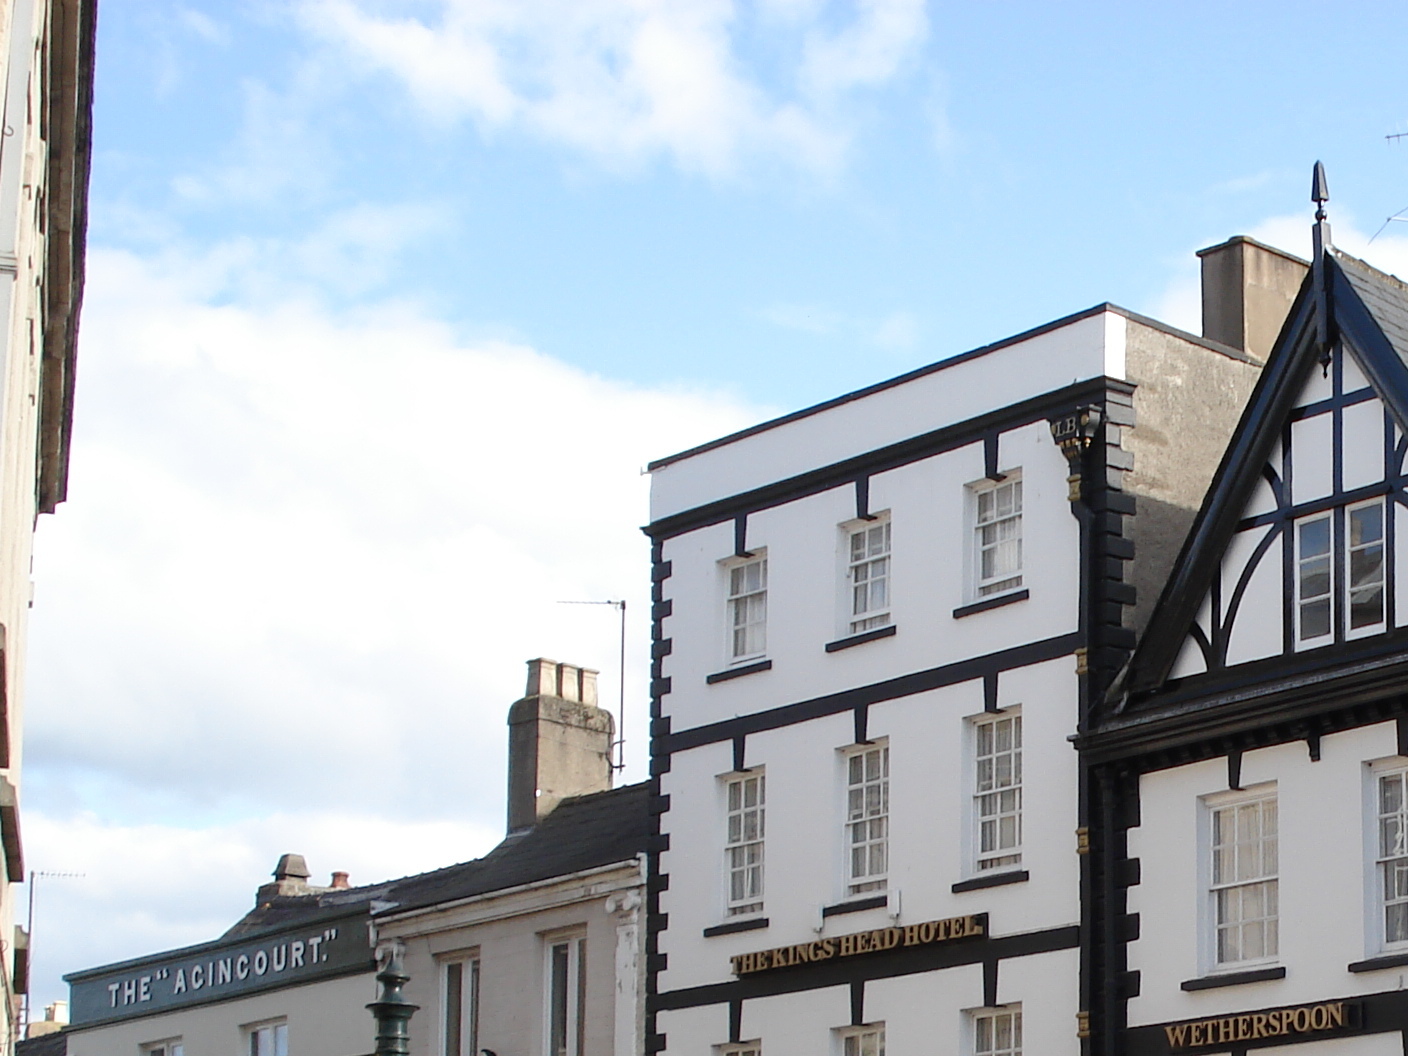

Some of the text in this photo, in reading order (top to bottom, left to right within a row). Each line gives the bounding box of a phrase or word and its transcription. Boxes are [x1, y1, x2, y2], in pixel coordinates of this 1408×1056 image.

[730, 915, 983, 976] THE KINGS HEAD HOTEL
[108, 976, 152, 1007] THE
[1165, 1002, 1343, 1048] WETHERSPOON
